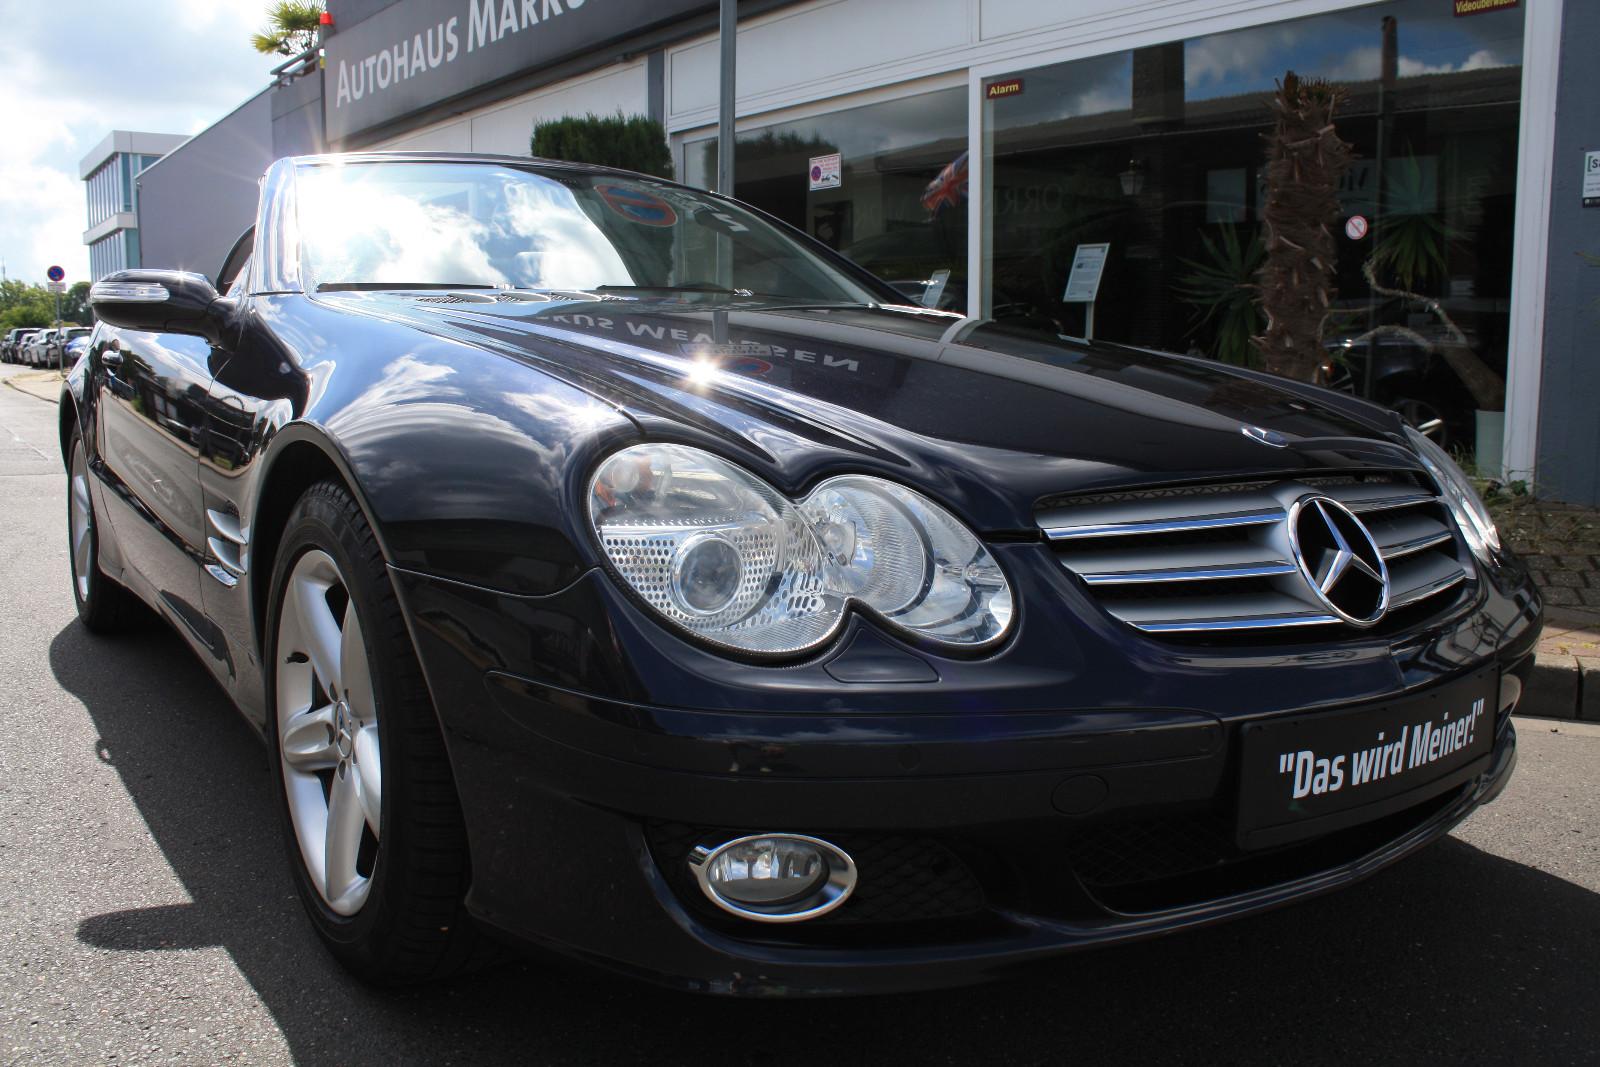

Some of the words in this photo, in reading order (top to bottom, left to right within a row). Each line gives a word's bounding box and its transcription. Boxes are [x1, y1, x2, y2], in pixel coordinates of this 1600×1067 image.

[336, 16, 458, 108] AUTOHAUS
[989, 83, 1019, 96] Alarm
[1279, 750, 1346, 799] "Das
[1352, 725, 1409, 786] wird
[1408, 698, 1485, 769] Meiner!"
